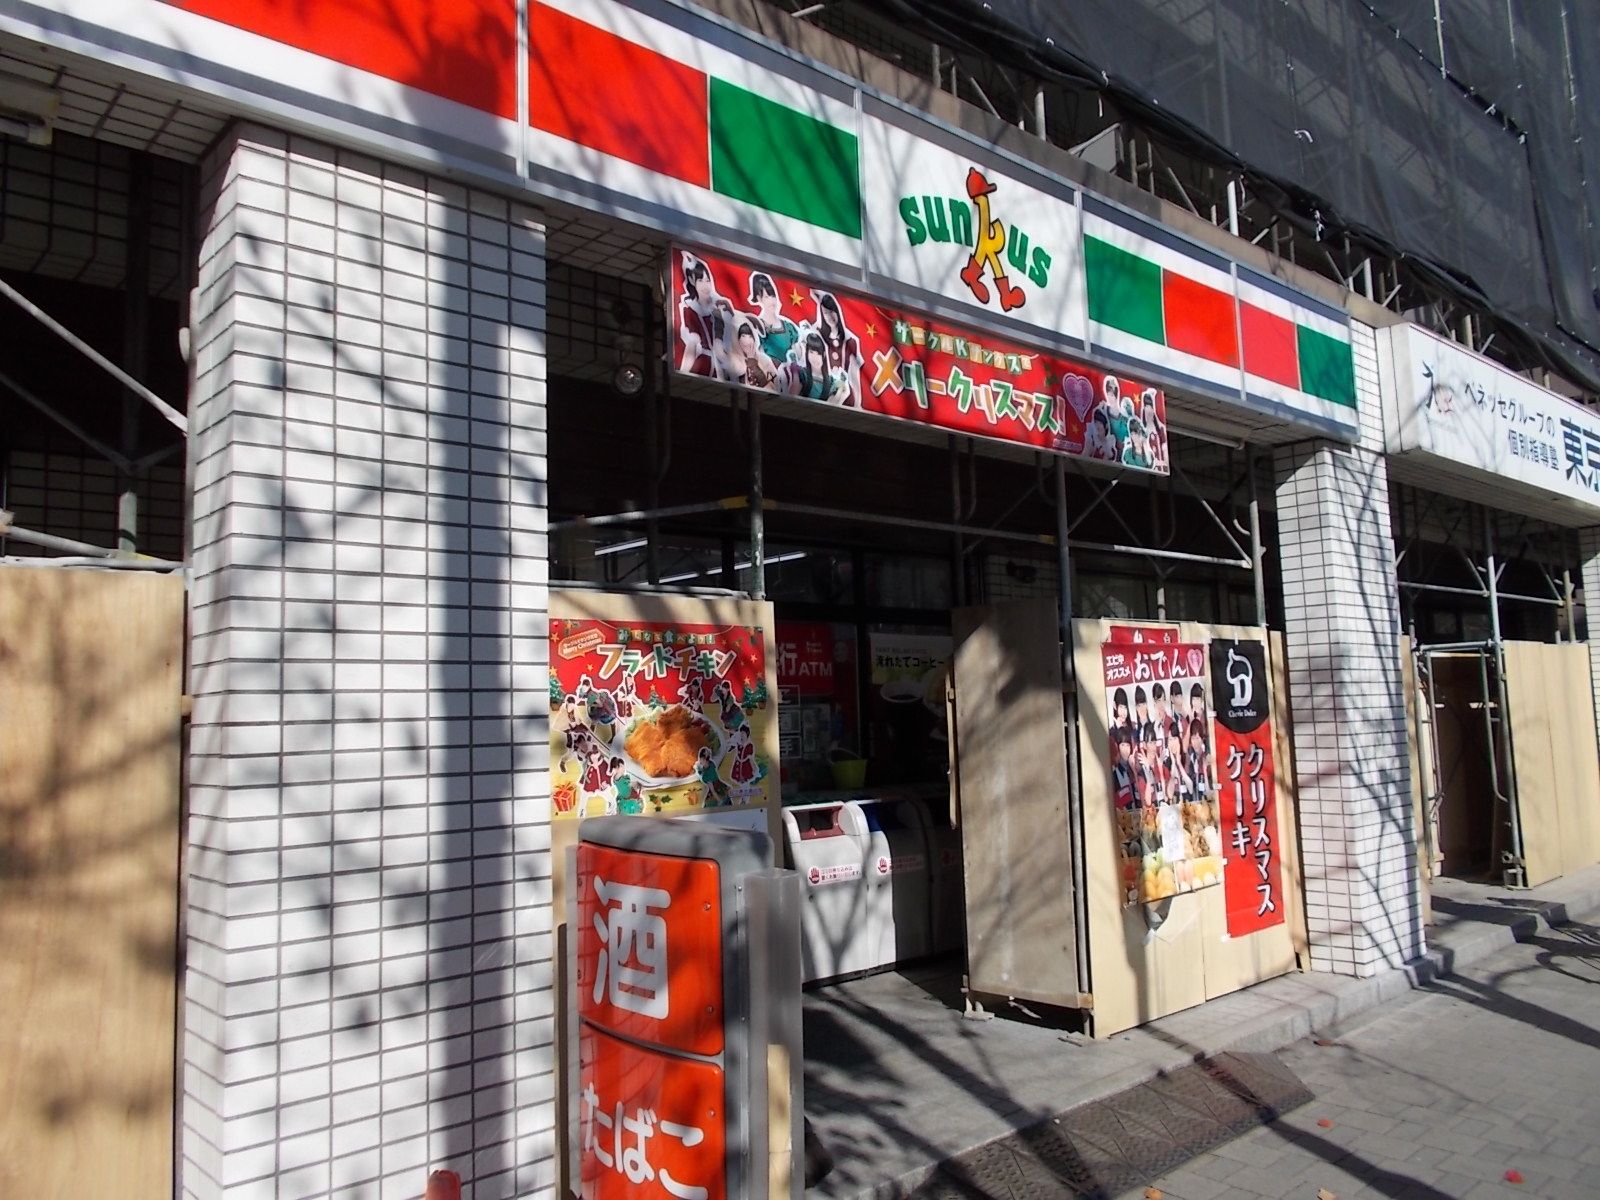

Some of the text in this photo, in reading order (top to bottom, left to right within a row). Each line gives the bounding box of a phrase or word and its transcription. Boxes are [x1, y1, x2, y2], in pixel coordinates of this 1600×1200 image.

[871, 346, 1066, 436] メリークリスマス!
[1465, 382, 1555, 437] ベネッセグループの
[1508, 429, 1560, 470] 個別指導塾
[597, 643, 737, 682] フライドチキン
[776, 643, 799, 677] 行
[800, 662, 833, 677] ATM
[1106, 665, 1131, 680] オススメ
[1135, 649, 1187, 680] おでん
[1226, 743, 1253, 858] ケーキ
[1248, 743, 1276, 916] クリスマス
[592, 875, 671, 1020] 酒
[584, 1083, 709, 1200] たばこ
